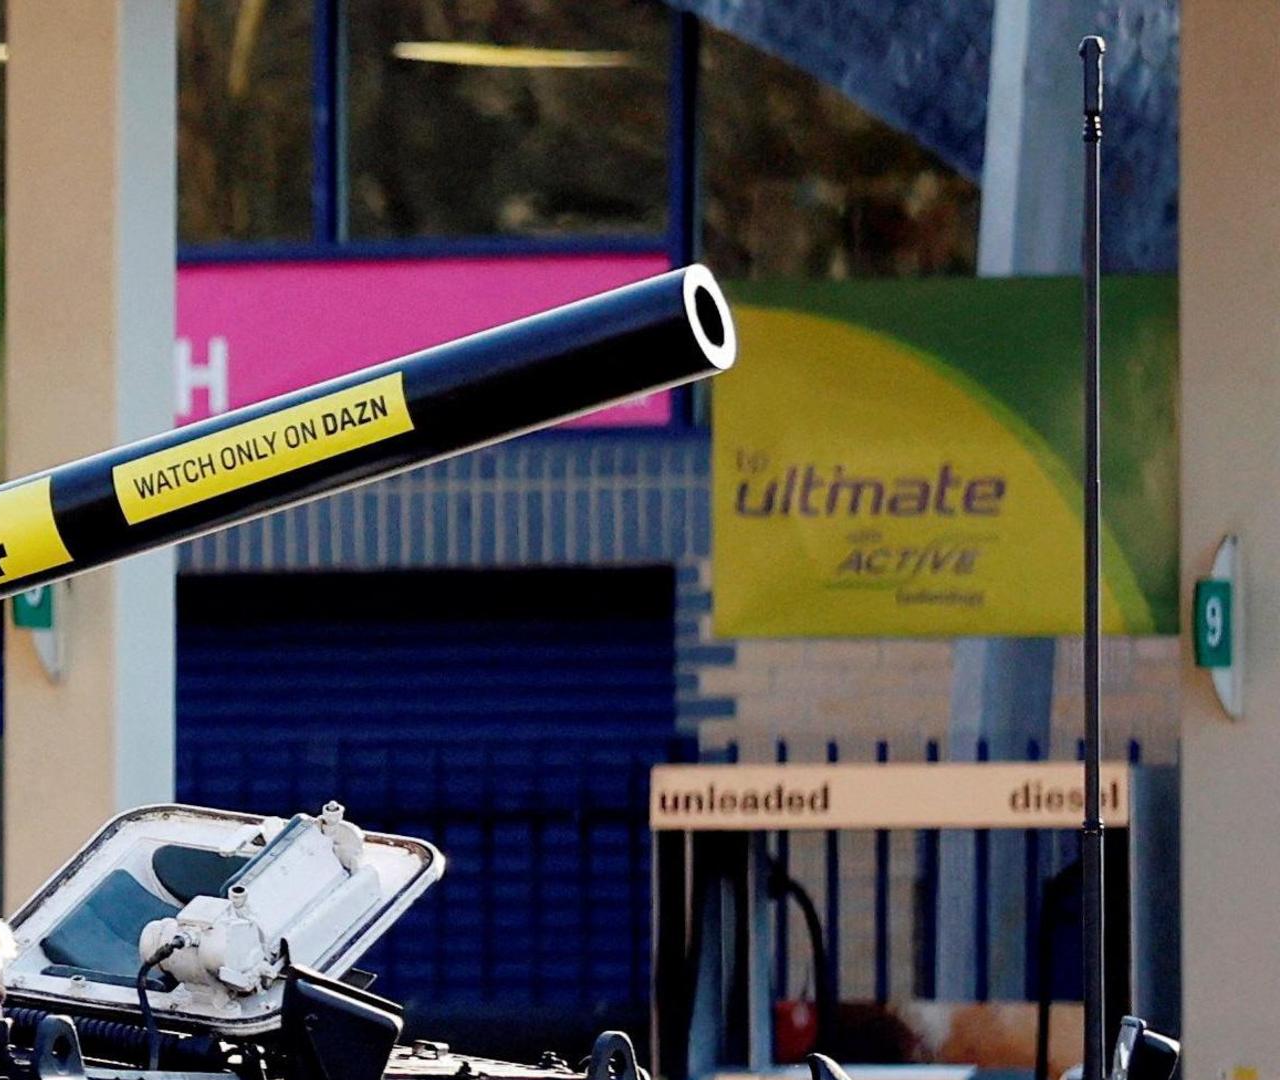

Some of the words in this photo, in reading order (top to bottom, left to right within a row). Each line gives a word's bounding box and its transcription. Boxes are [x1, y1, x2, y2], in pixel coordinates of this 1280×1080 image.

[132, 453, 217, 500] WATCH
[220, 431, 278, 471] ONLY
[284, 418, 318, 449] ON
[321, 395, 389, 437] DAZN
[736, 461, 1007, 517] ultimate
[837, 546, 981, 576] ACTIVE
[1204, 600, 1222, 647] 9
[660, 783, 830, 813] unleaded
